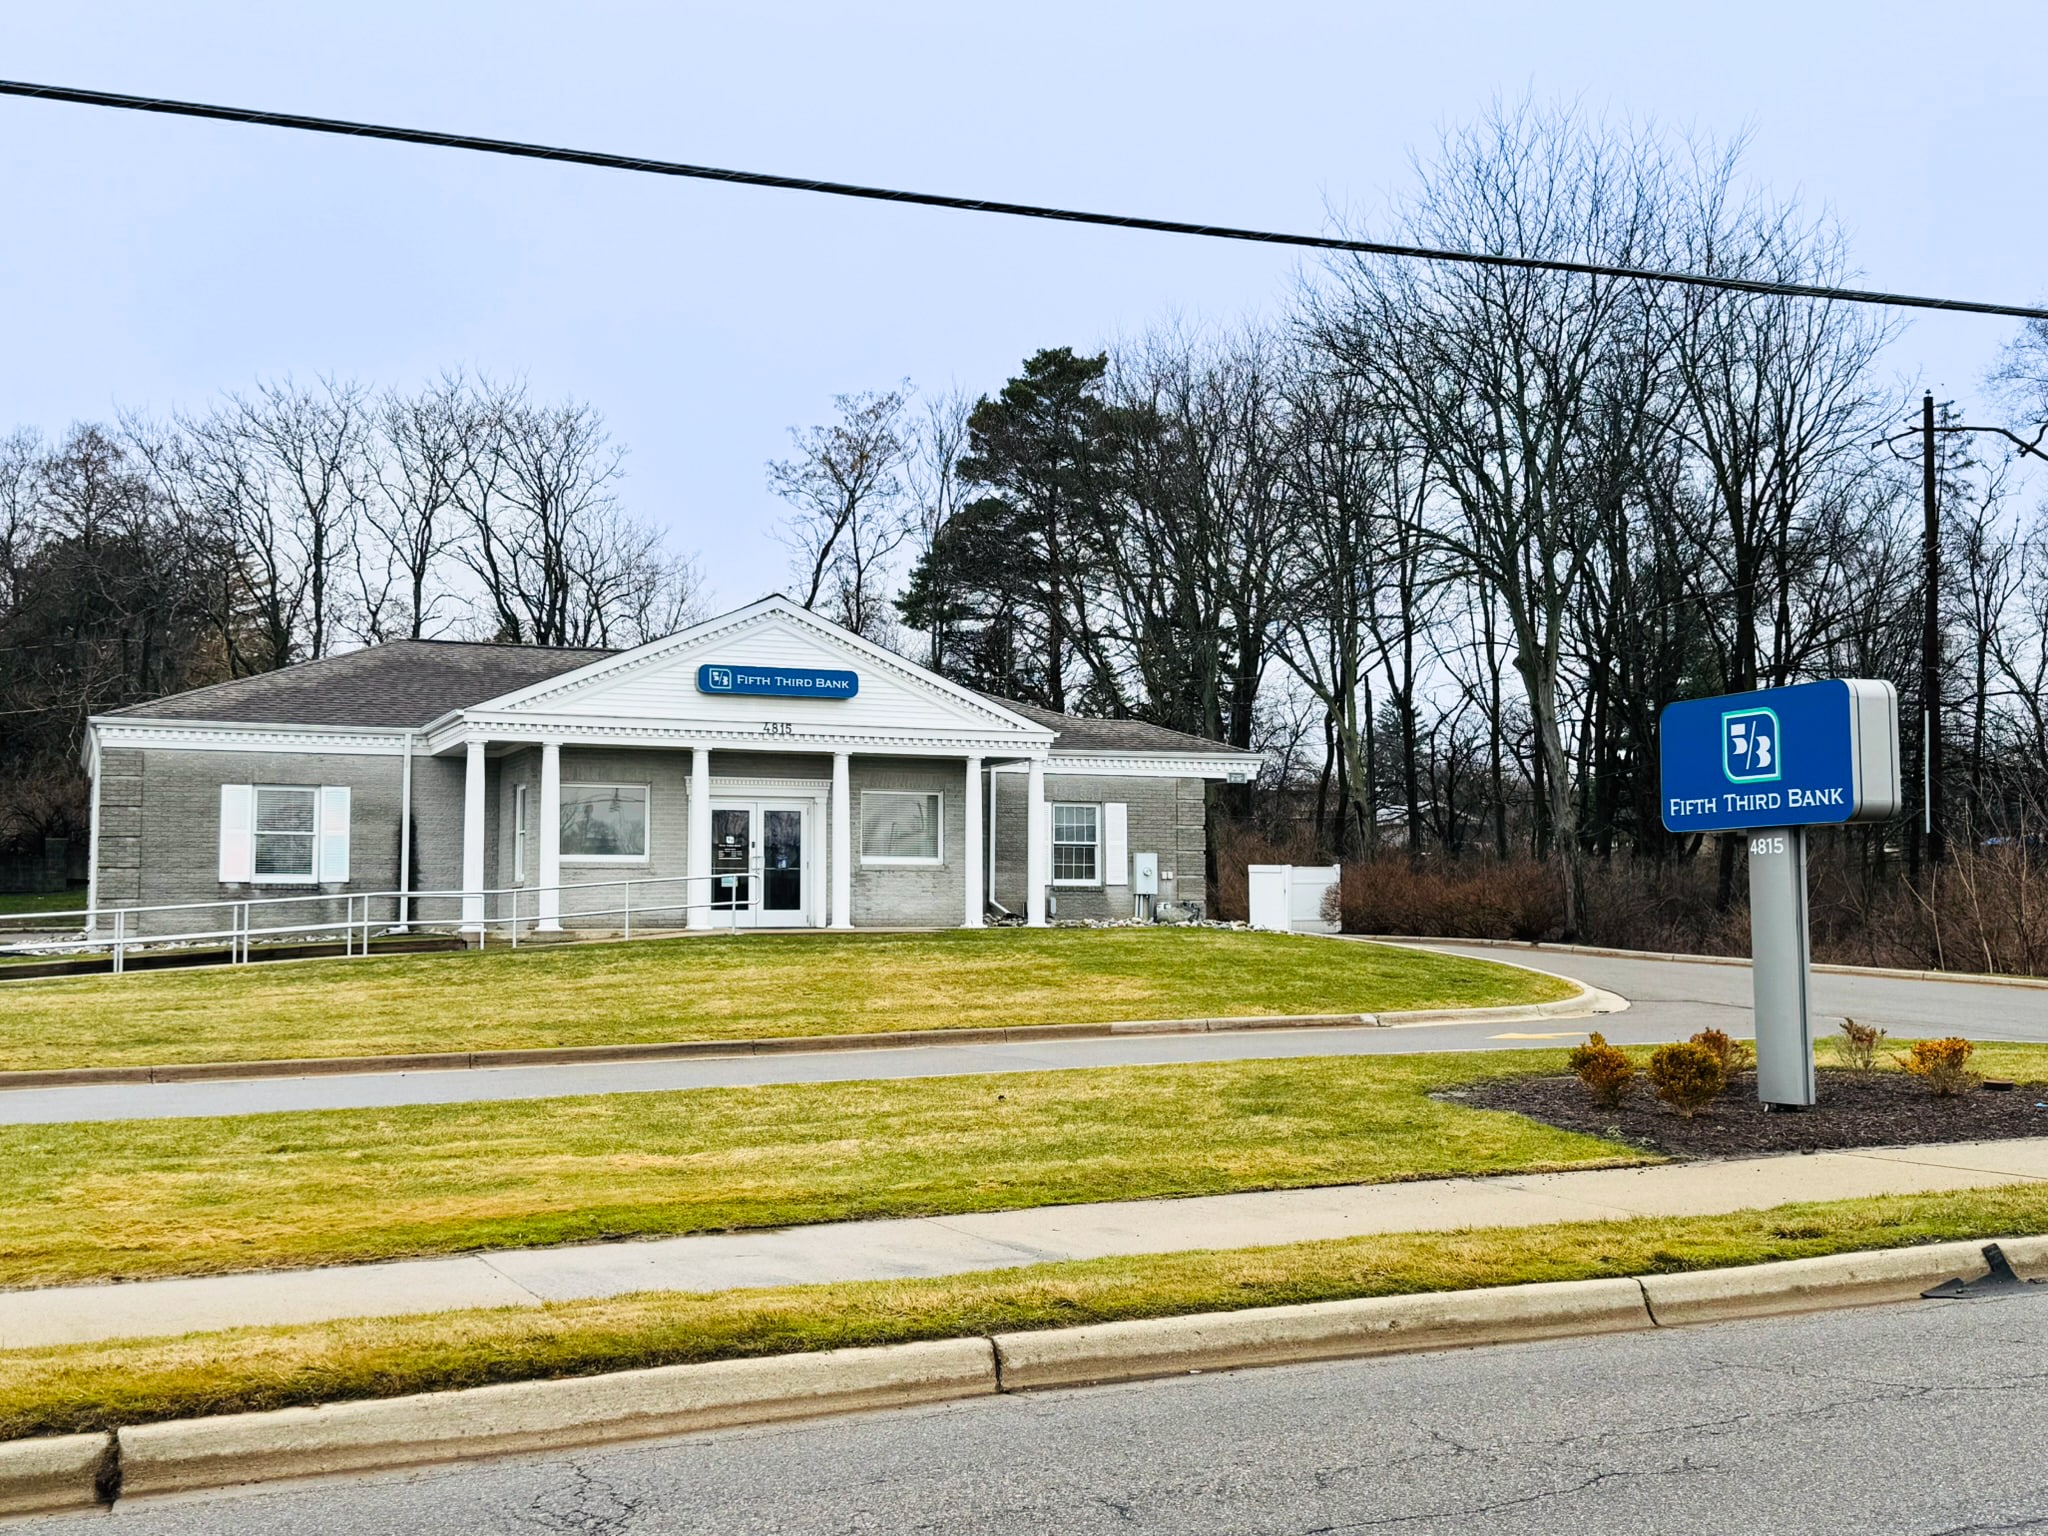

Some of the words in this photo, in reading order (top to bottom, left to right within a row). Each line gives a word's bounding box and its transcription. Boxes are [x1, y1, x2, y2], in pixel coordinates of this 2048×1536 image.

[737, 674, 771, 686] FIFTH
[775, 676, 812, 688] THIRD
[815, 678, 850, 689] BANK
[763, 722, 792, 735] 4815
[1670, 797, 1717, 816] FIFTH
[1723, 792, 1781, 812] THIRD
[1787, 788, 1844, 808] BANK
[1750, 837, 1784, 855] 4815
